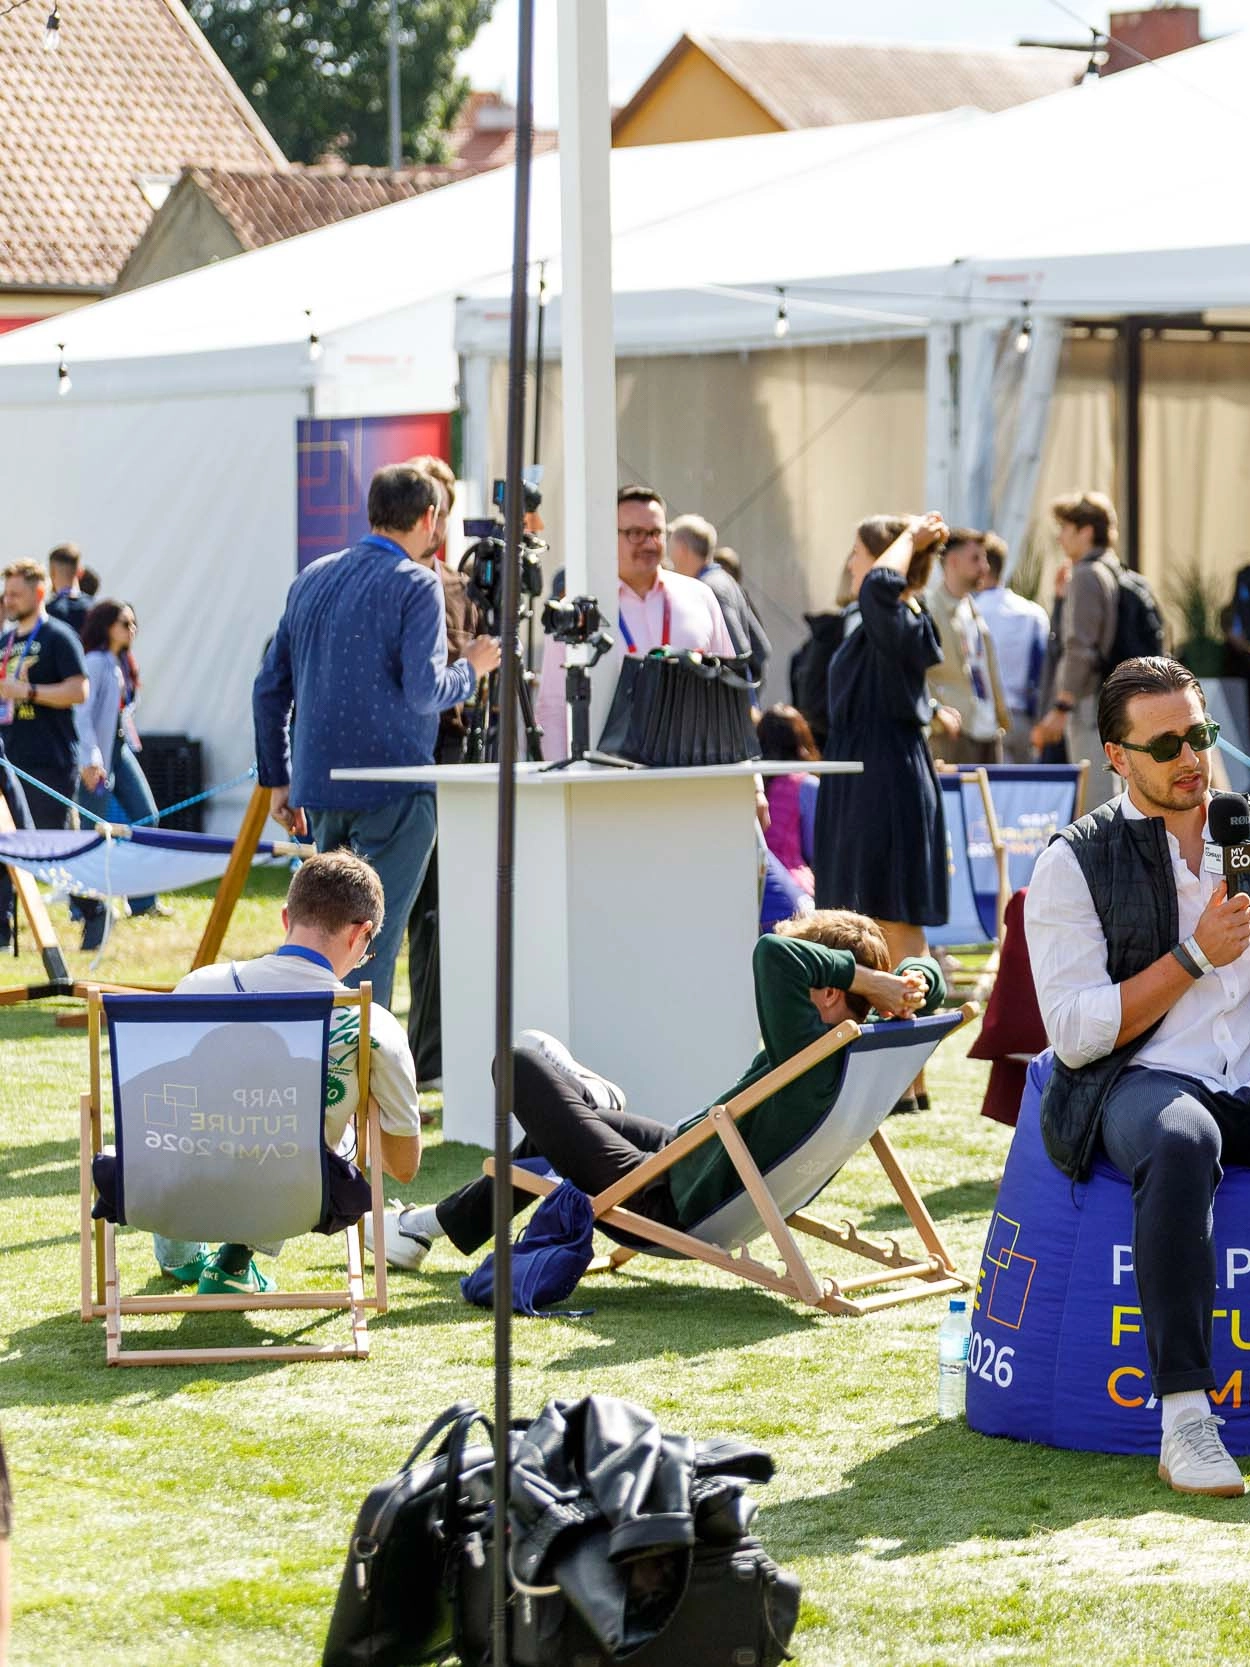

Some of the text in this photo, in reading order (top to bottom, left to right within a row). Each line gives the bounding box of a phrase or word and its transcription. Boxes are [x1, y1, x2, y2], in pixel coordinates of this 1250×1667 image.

[1230, 816, 1250, 825] RØD
[1231, 847, 1244, 857] MY
[1231, 854, 1250, 868] CO
[967, 1326, 1015, 1388] 026
